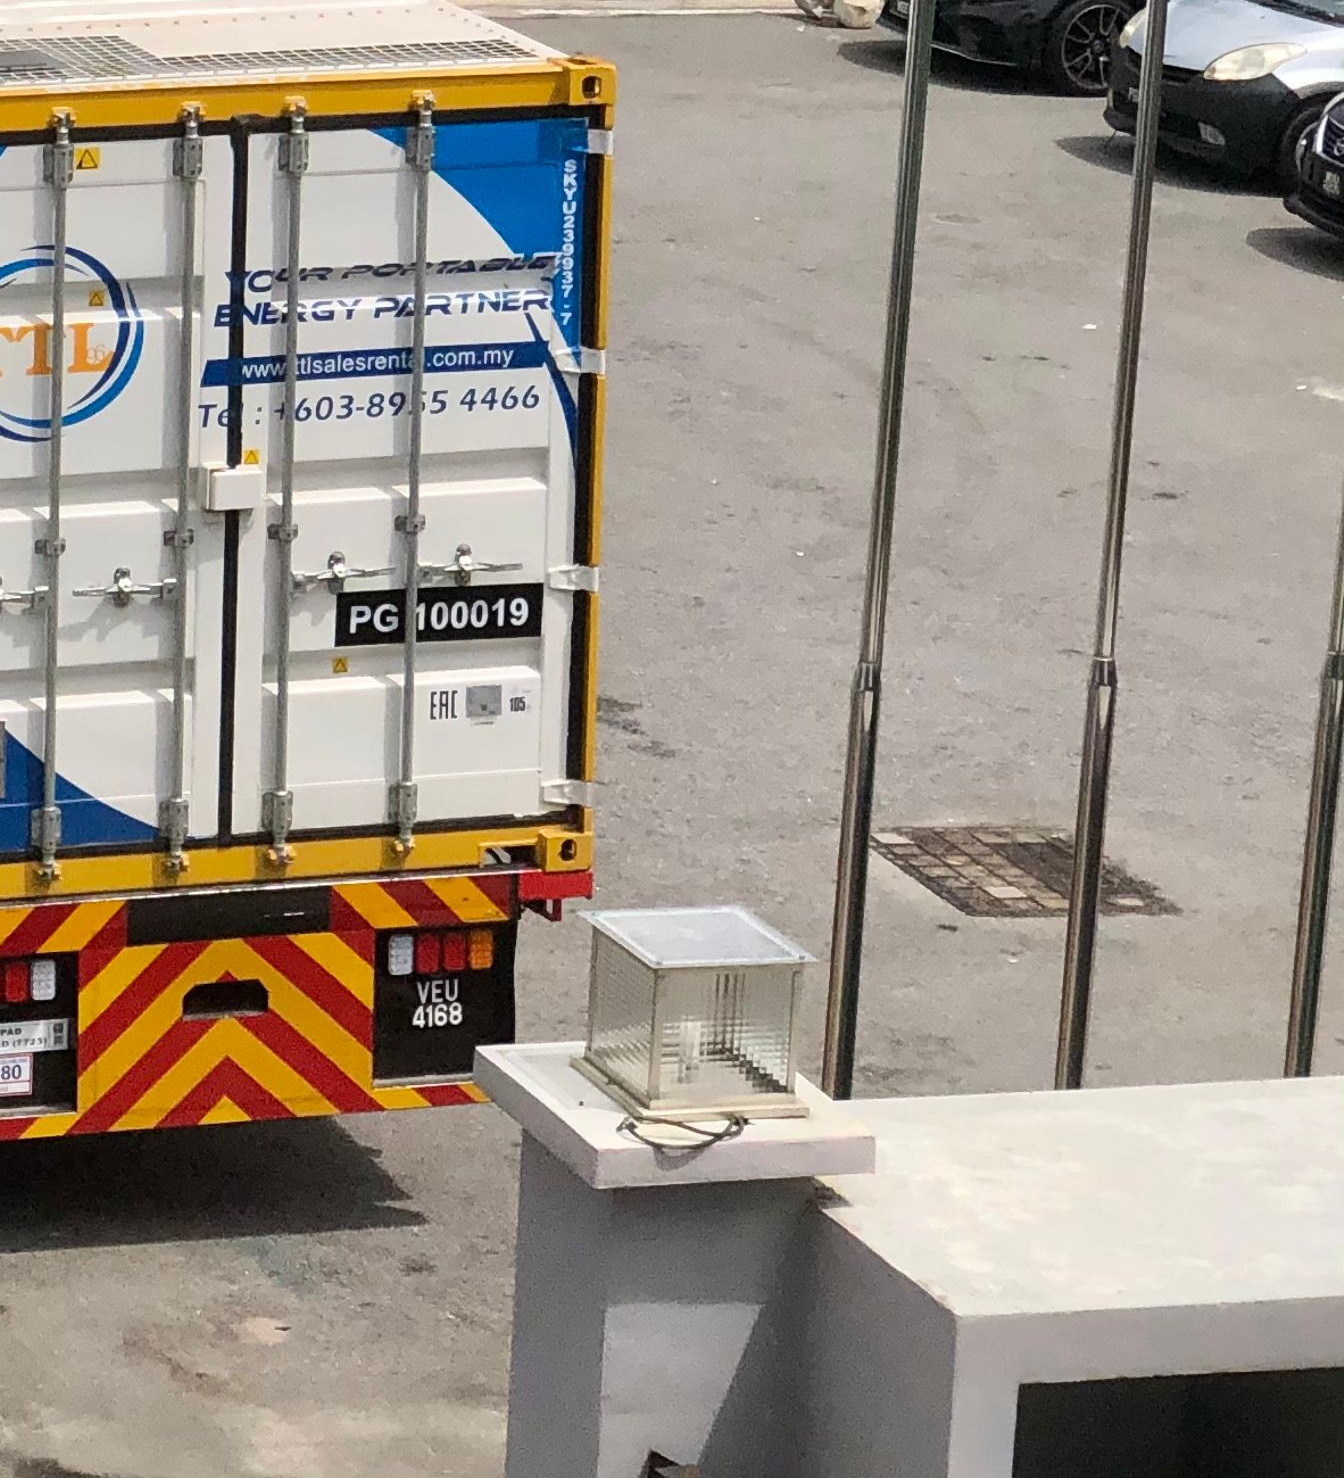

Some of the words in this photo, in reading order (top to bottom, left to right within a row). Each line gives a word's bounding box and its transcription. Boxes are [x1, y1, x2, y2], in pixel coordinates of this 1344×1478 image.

[374, 289, 552, 320] PARTNER
[242, 349, 515, 379] wwwttlsalesrenta.com.my
[198, 402, 243, 428] Te
[459, 384, 541, 413] 4466
[349, 603, 399, 634] PG
[415, 597, 530, 631] 100019
[416, 978, 459, 1004] VEU
[412, 1002, 463, 1029] 4168
[0, 1064, 22, 1081] 80
